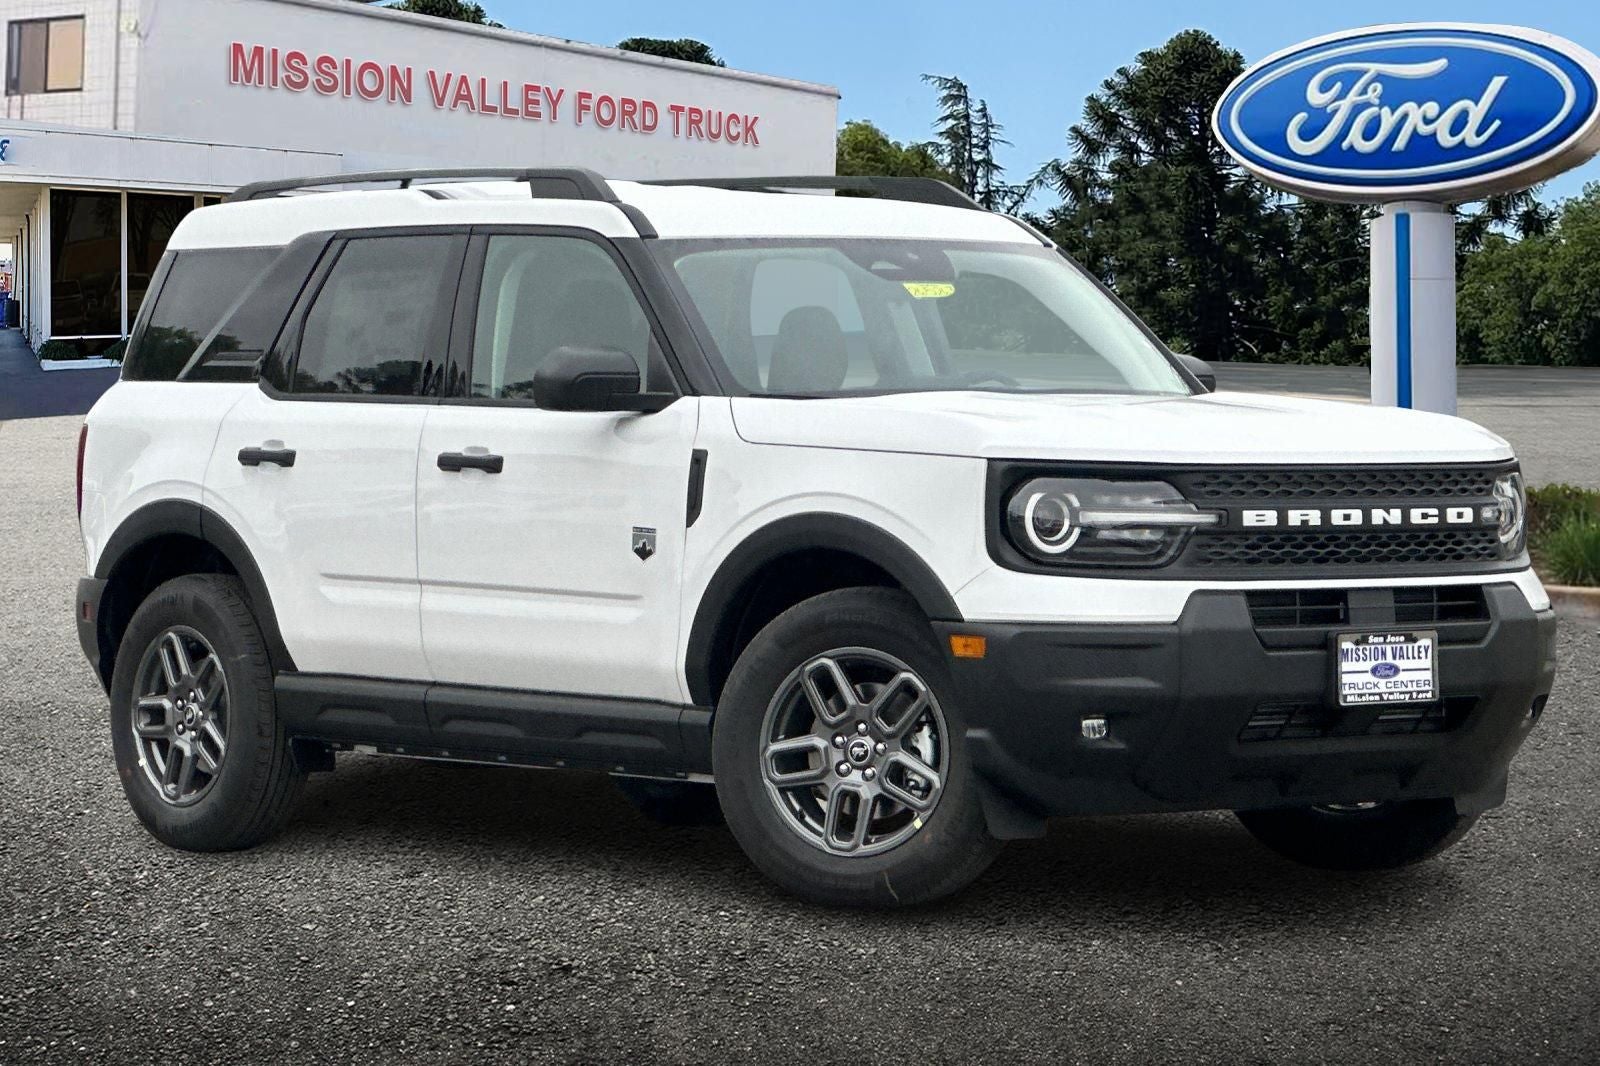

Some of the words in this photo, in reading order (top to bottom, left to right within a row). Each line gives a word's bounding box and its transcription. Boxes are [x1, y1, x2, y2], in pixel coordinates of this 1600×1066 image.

[229, 41, 413, 104] MISSION
[427, 70, 565, 122] VALLEY
[576, 90, 659, 134] FORD
[669, 103, 761, 146] TRUCK
[1286, 58, 1509, 156] Ford
[1242, 507, 1474, 527] BRONCO
[1341, 646, 1387, 663] MISSION
[1391, 645, 1430, 661] VALLEY
[1341, 681, 1380, 691] TRUCK
[1385, 679, 1431, 689] CENTER
